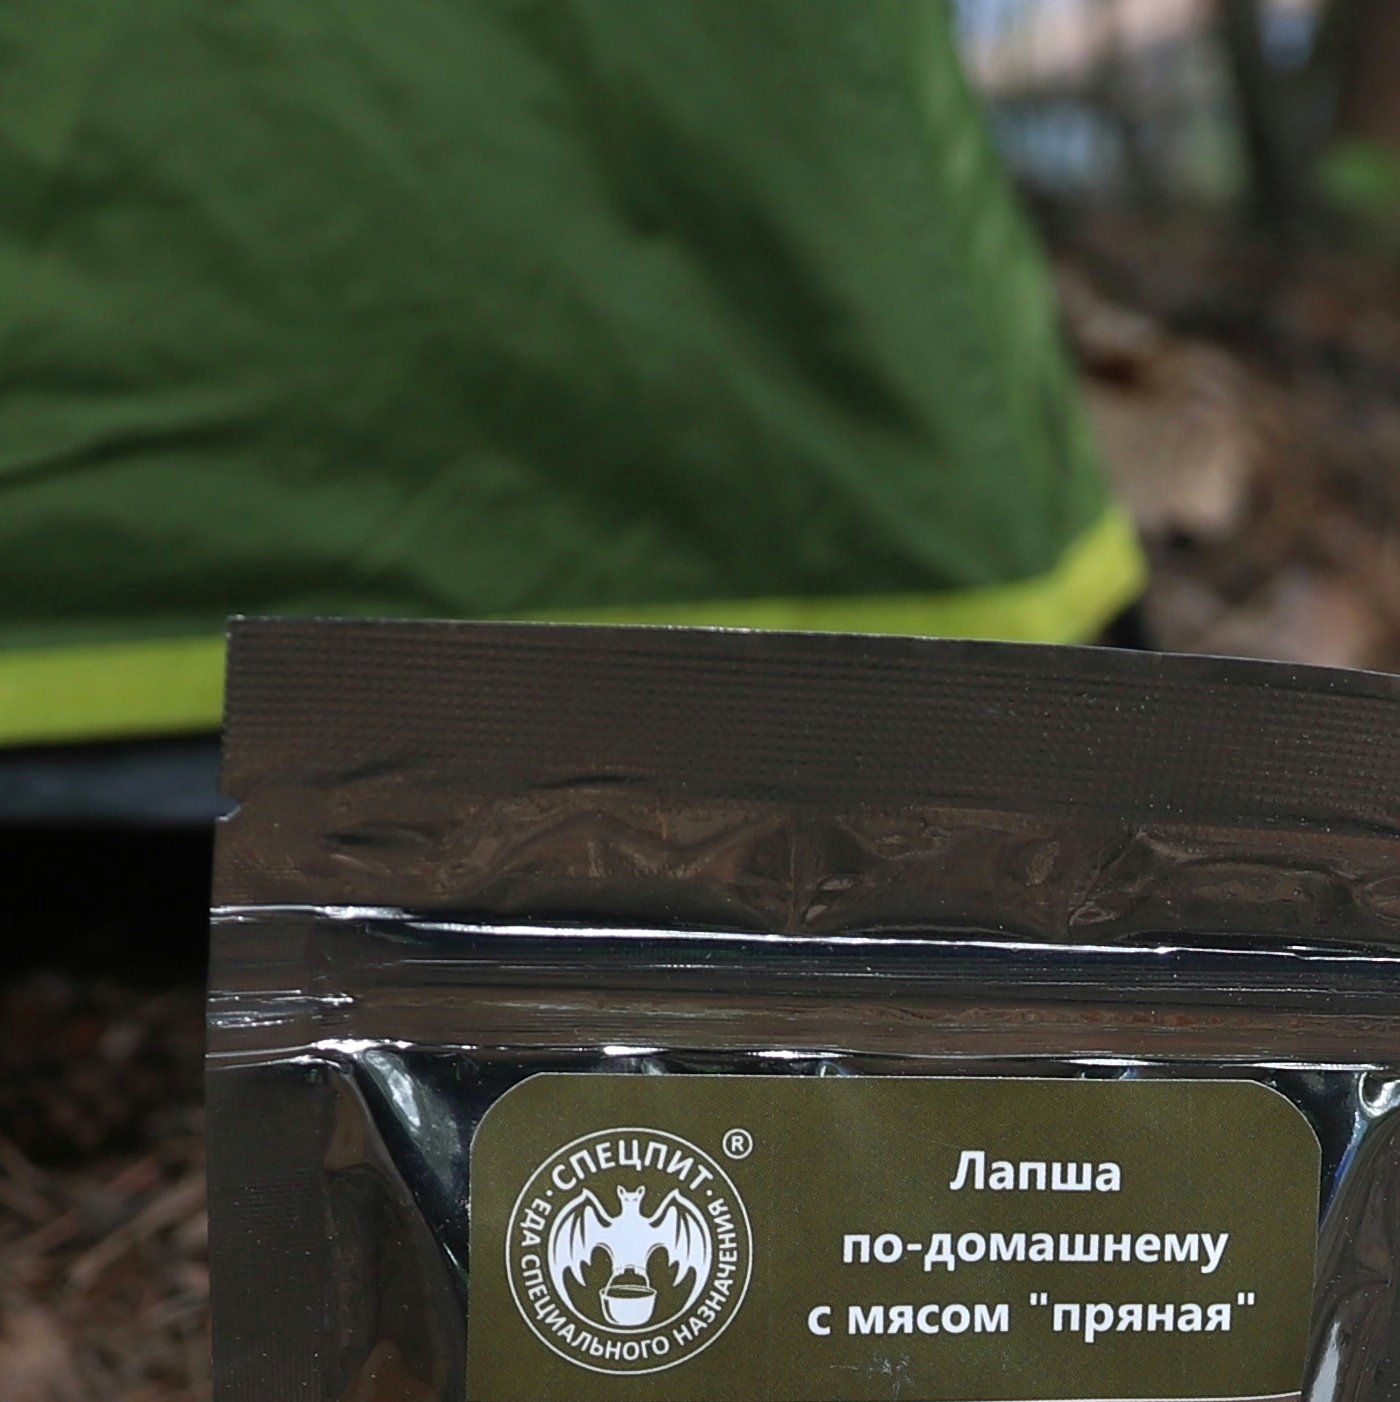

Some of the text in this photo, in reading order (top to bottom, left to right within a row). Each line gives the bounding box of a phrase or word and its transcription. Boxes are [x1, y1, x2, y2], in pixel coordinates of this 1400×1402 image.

[551, 1139, 714, 1191] СПЕЦПИТ
[949, 1150, 1121, 1192] Лапша
[843, 1232, 1229, 1274] по-домашнему
[519, 1198, 738, 1361] ЕДА СПЕЦИАЛЬНОГО НАЗНАЧЕНИЯ
[807, 1292, 1255, 1343] с мясом "пряная"
